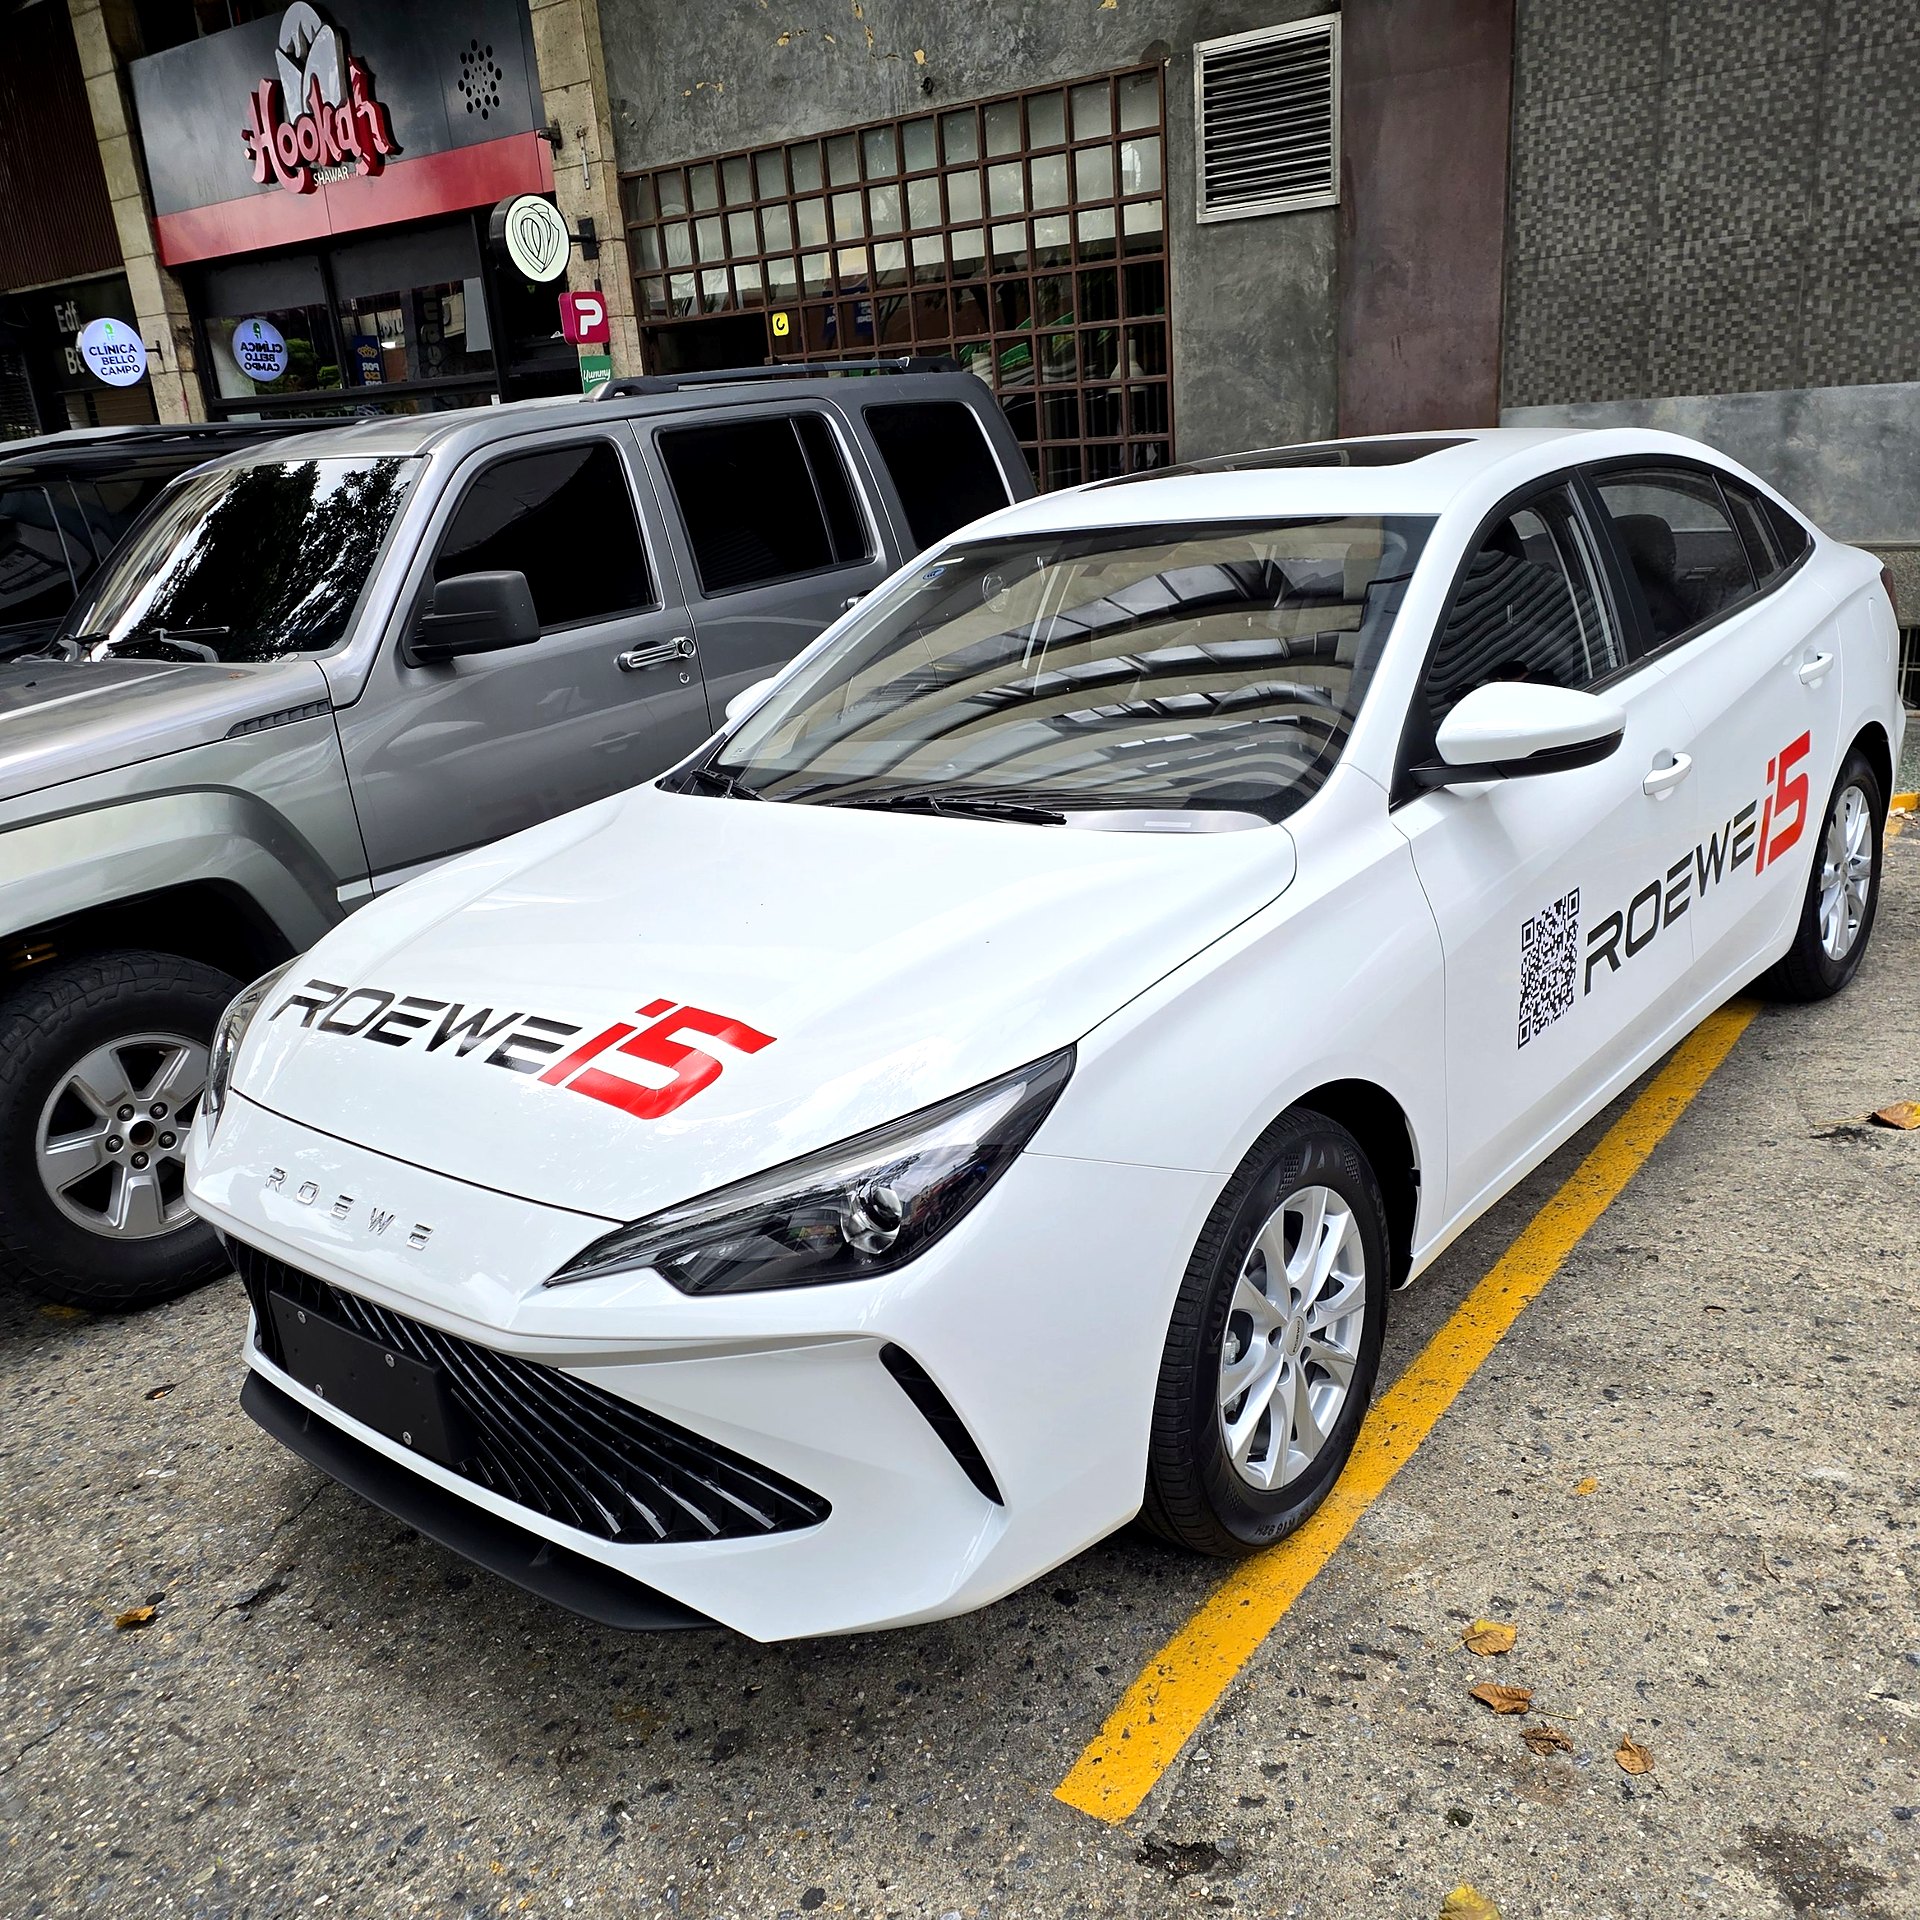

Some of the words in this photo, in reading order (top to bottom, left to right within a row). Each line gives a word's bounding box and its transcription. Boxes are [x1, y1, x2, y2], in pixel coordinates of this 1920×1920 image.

[313, 165, 358, 187] SHAWAR
[89, 342, 137, 356] CLÍNICA
[100, 364, 141, 376] CAMPO
[101, 355, 136, 366] BELLO
[583, 368, 611, 383] Yummy
[1584, 799, 1758, 996] ROEWE
[267, 979, 583, 1075] ROEWE
[264, 1166, 434, 1251] ROEWE
[1206, 1226, 1252, 1354] KUMHO
